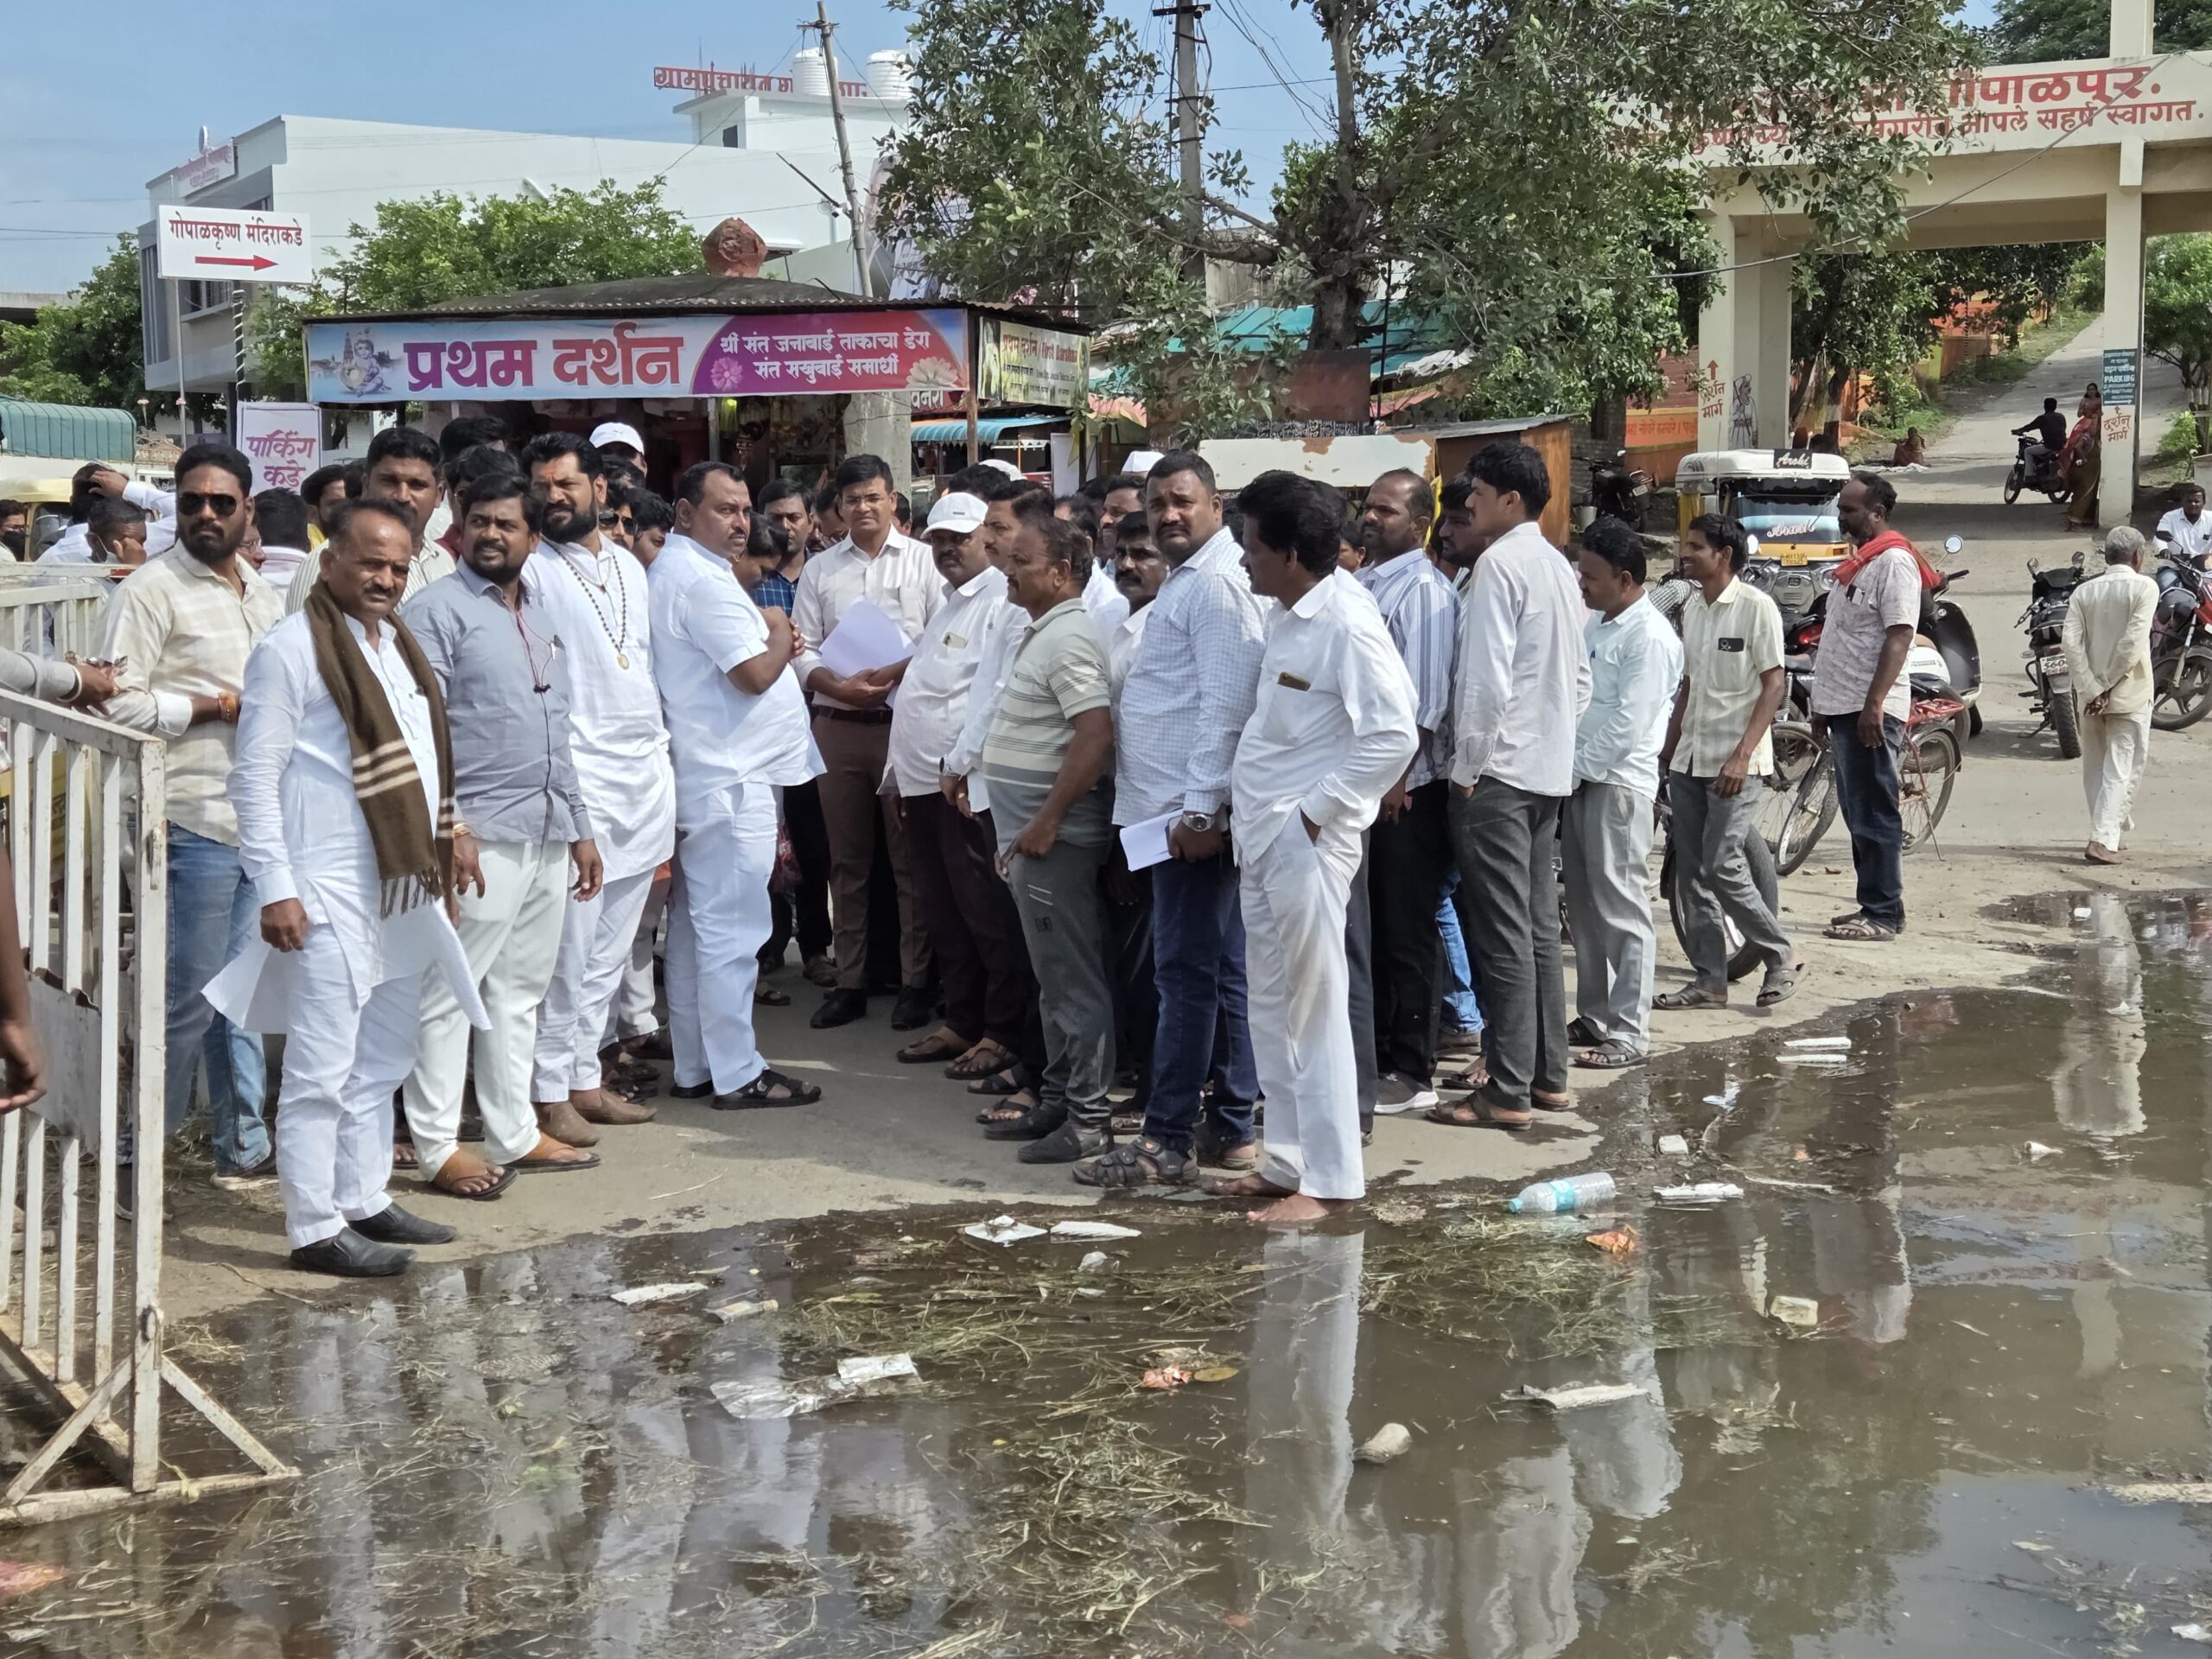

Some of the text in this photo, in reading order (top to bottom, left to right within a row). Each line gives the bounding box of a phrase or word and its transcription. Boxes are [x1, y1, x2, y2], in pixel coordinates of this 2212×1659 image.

[1957, 105, 2028, 137] आपले
[2037, 101, 2098, 133] सहर्ष
[2106, 99, 2204, 126] स्वागत.
[168, 211, 303, 250] गोपाळकृष्ण मंदिराकडे
[720, 326, 931, 354] श्री संत जनाबाई ताकाचा डेरा
[404, 321, 684, 391] प्रथम दर्शन
[753, 352, 899, 385] संत सखुबाई समाधी
[2104, 374, 2135, 384] PARKING
[1701, 398, 1723, 418] मार्ग
[245, 429, 316, 458] पार्किंग
[2107, 427, 2128, 442] मार्ग
[264, 459, 306, 486] कडे
